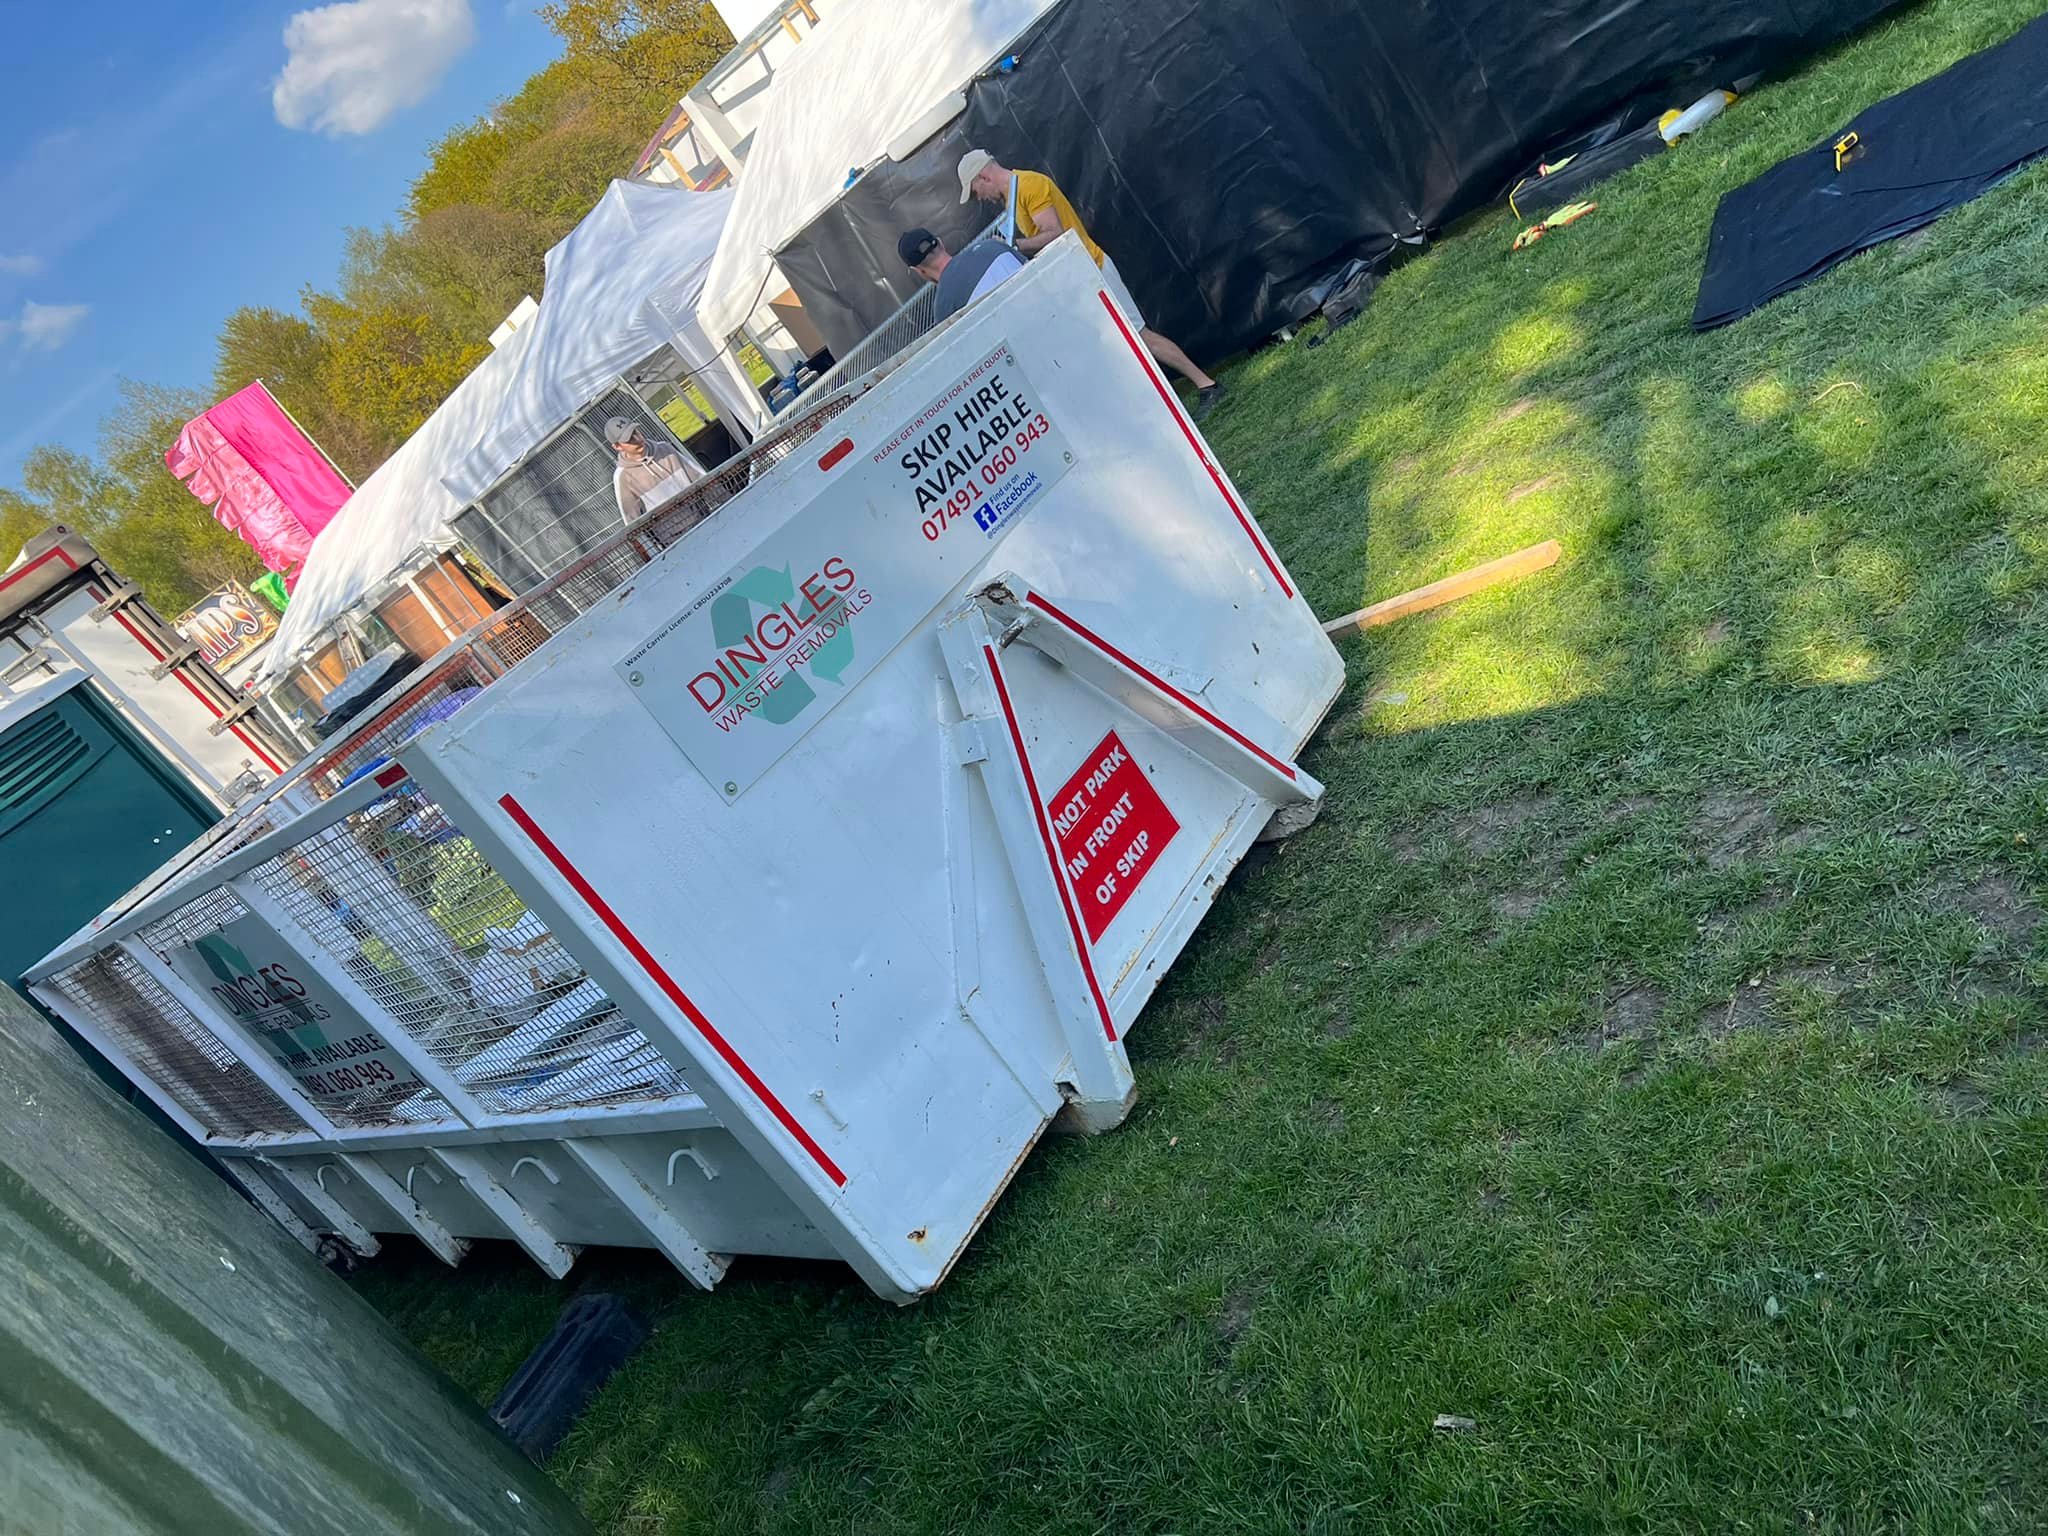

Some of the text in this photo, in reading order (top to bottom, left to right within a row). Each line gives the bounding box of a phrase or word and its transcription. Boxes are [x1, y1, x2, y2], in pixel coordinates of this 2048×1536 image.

[873, 346, 1008, 463] PLEASE GET IN TOUCH FOR A FREE QUOTE
[901, 374, 1009, 479] SKIP HIRE
[914, 394, 1032, 514] AVAILABLE
[922, 414, 1050, 541] 07491 060 943
[989, 474, 1021, 504] Find us on
[995, 472, 1038, 515] Facebook
[625, 648, 647, 667] Waste
[646, 629, 669, 650] Carrier
[668, 608, 694, 631] License:
[686, 556, 855, 713] DINGLES
[715, 588, 873, 733] WASTE REMOVALS
[1053, 745, 1127, 837] NOT PARK
[1066, 792, 1135, 880] IN FRONT
[1095, 830, 1150, 905] OF SKIP
[211, 963, 306, 1015] DINGLES
[311, 1033, 386, 1066] AVAILABLE
[327, 1068, 363, 1092] 060
[354, 1060, 395, 1087] 943
